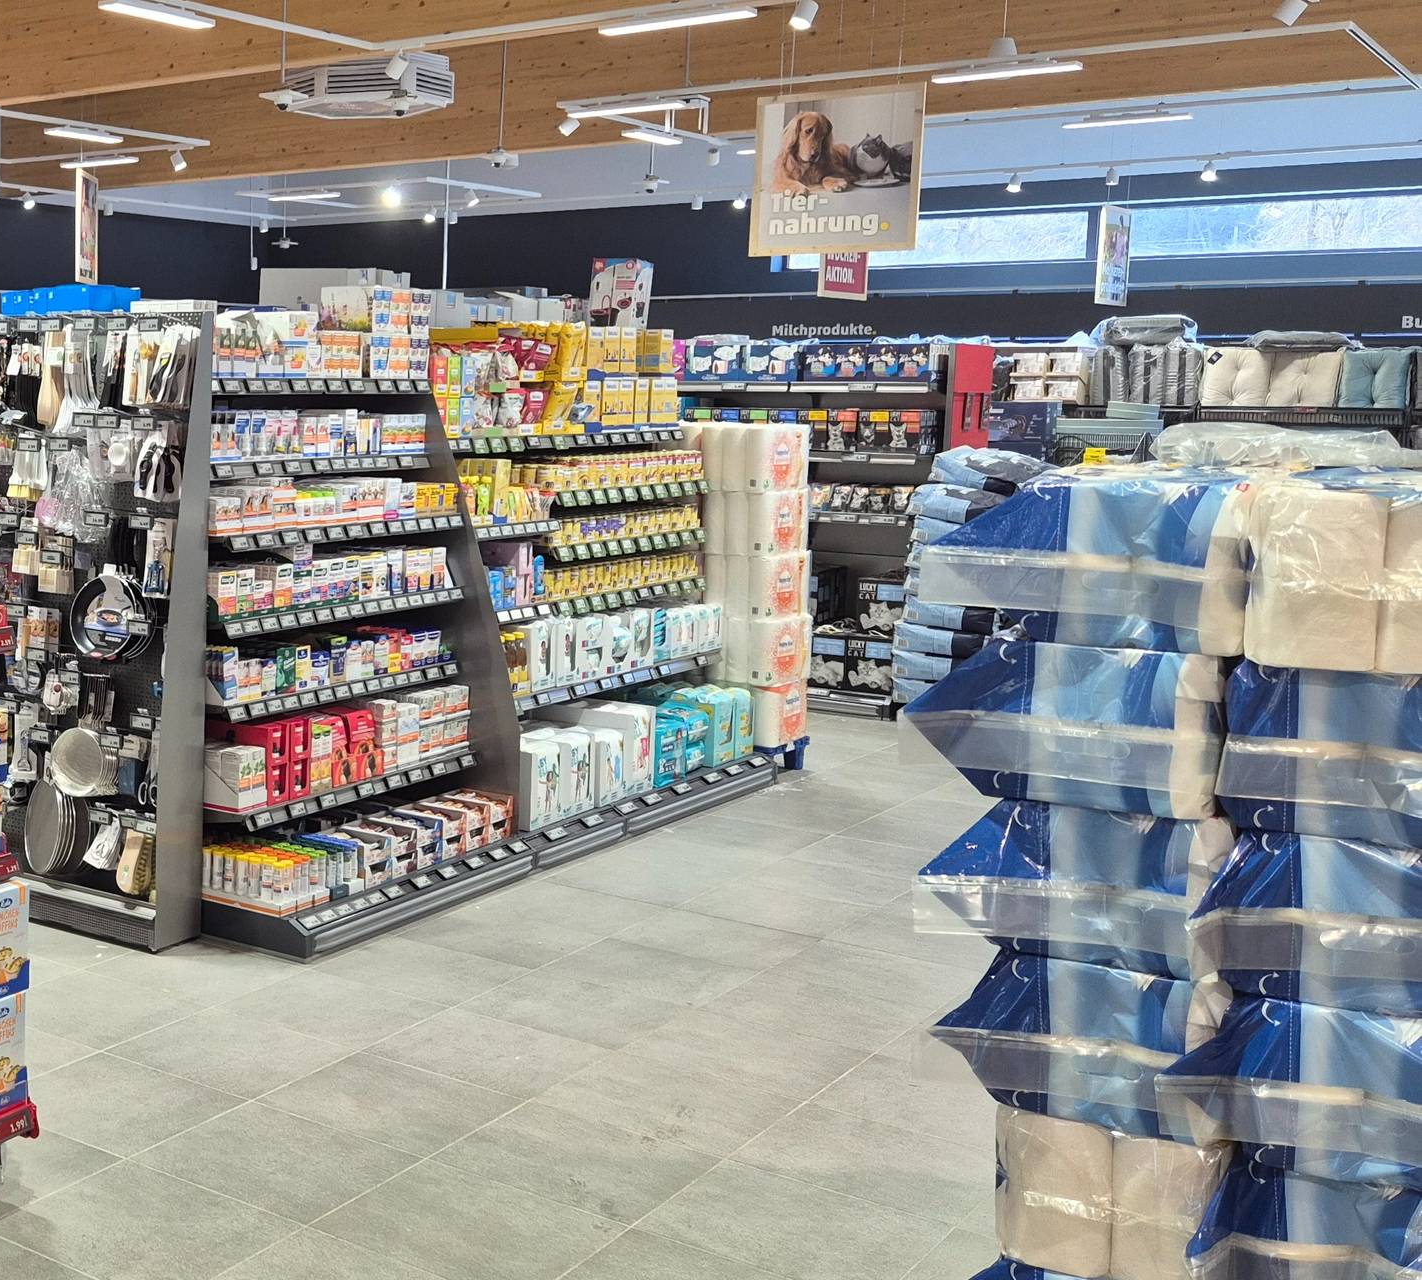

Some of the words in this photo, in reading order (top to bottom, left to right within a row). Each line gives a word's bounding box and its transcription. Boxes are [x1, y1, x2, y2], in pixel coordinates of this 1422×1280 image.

[770, 189, 828, 213] Tier-
[768, 213, 890, 235] nahrung.
[825, 266, 855, 284] AKTION.
[771, 323, 877, 337] Milchprodukte.
[859, 582, 877, 591] LUCKY
[10, 1119, 25, 1134] 1.99
